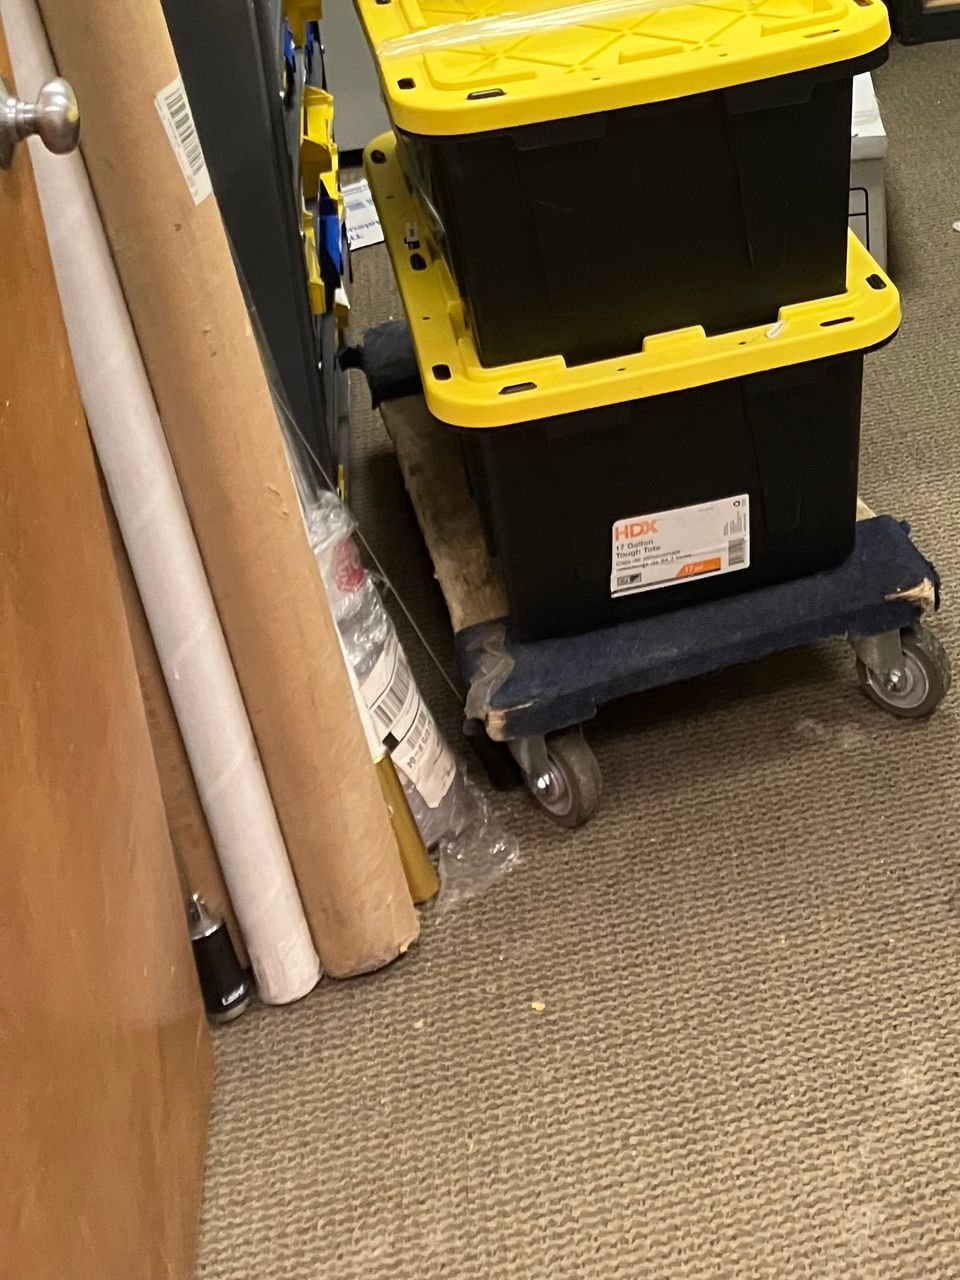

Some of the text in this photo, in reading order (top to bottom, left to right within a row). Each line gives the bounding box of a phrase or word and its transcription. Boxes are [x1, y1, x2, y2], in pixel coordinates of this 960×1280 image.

[615, 519, 658, 541] HDX
[616, 544, 660, 559] Tough Tote
[627, 539, 653, 549] Gallon
